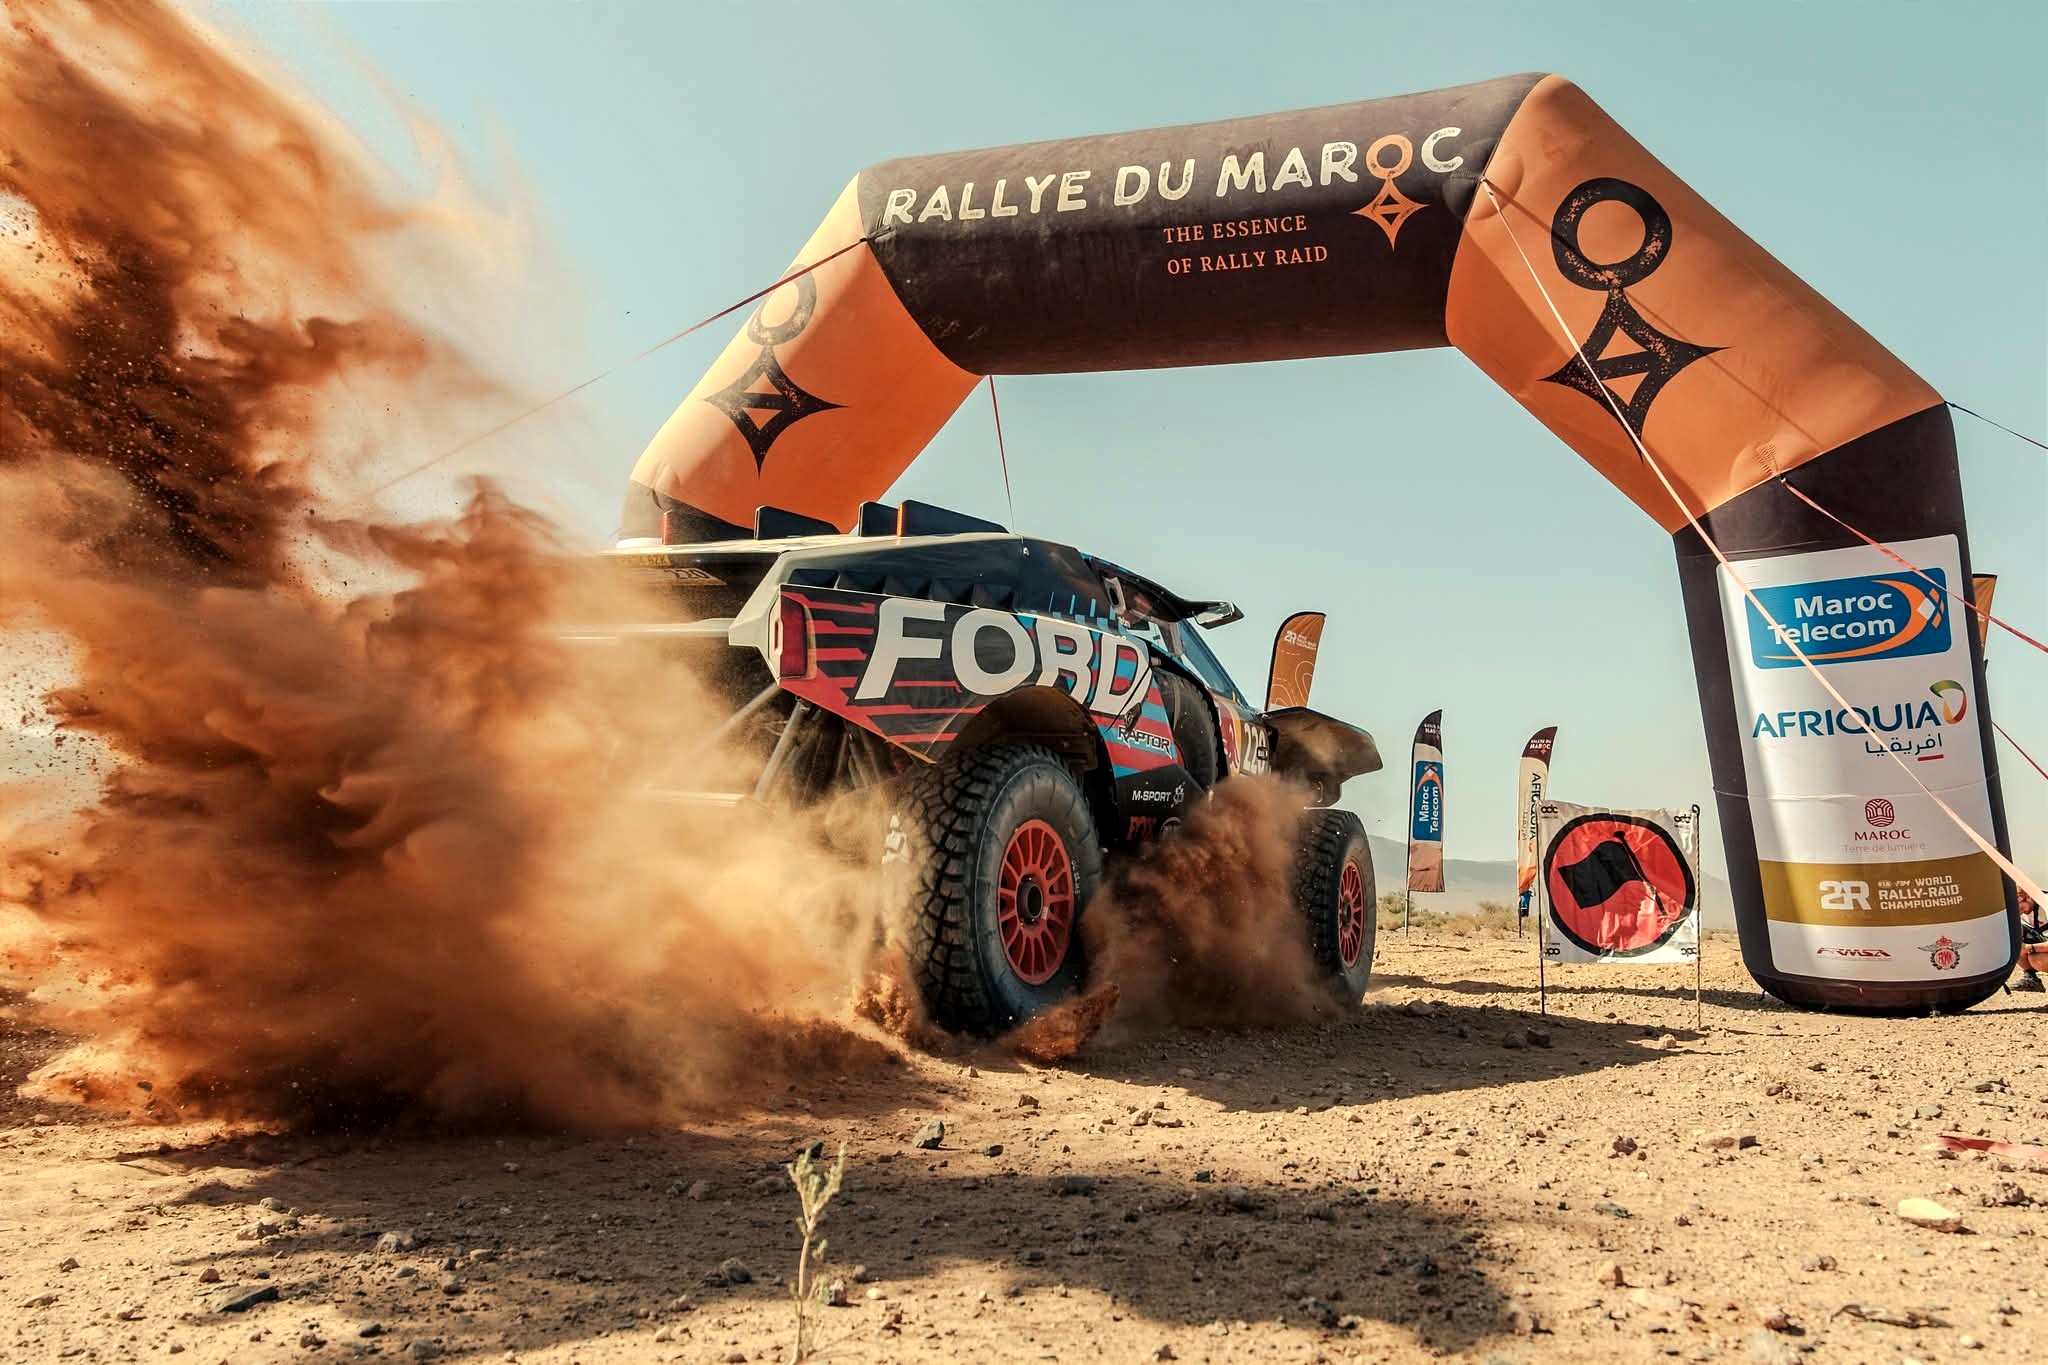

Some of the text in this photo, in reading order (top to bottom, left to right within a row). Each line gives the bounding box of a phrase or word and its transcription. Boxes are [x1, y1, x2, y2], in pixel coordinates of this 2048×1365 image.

[882, 126, 1464, 225] RALLYE DU MAROC
[1163, 215, 1307, 243] THE ESSENCE
[1167, 245, 1329, 275] OF RALLY RAID
[1793, 592, 1893, 619] Maroc
[1767, 617, 1896, 645] Telecom
[854, 597, 1153, 716] FORD
[1752, 700, 1942, 738] AFRIQUIA
[1117, 725, 1173, 760] RAPTOR
[1418, 785, 1430, 822] Maroc
[1430, 786, 1439, 833] Telecom
[1854, 829, 1912, 841] MAROC
[1878, 884, 1961, 901] RALLY-RAID
[1914, 875, 1953, 887] WORLD
[1880, 895, 1964, 910] CHAMPIONSHIP
